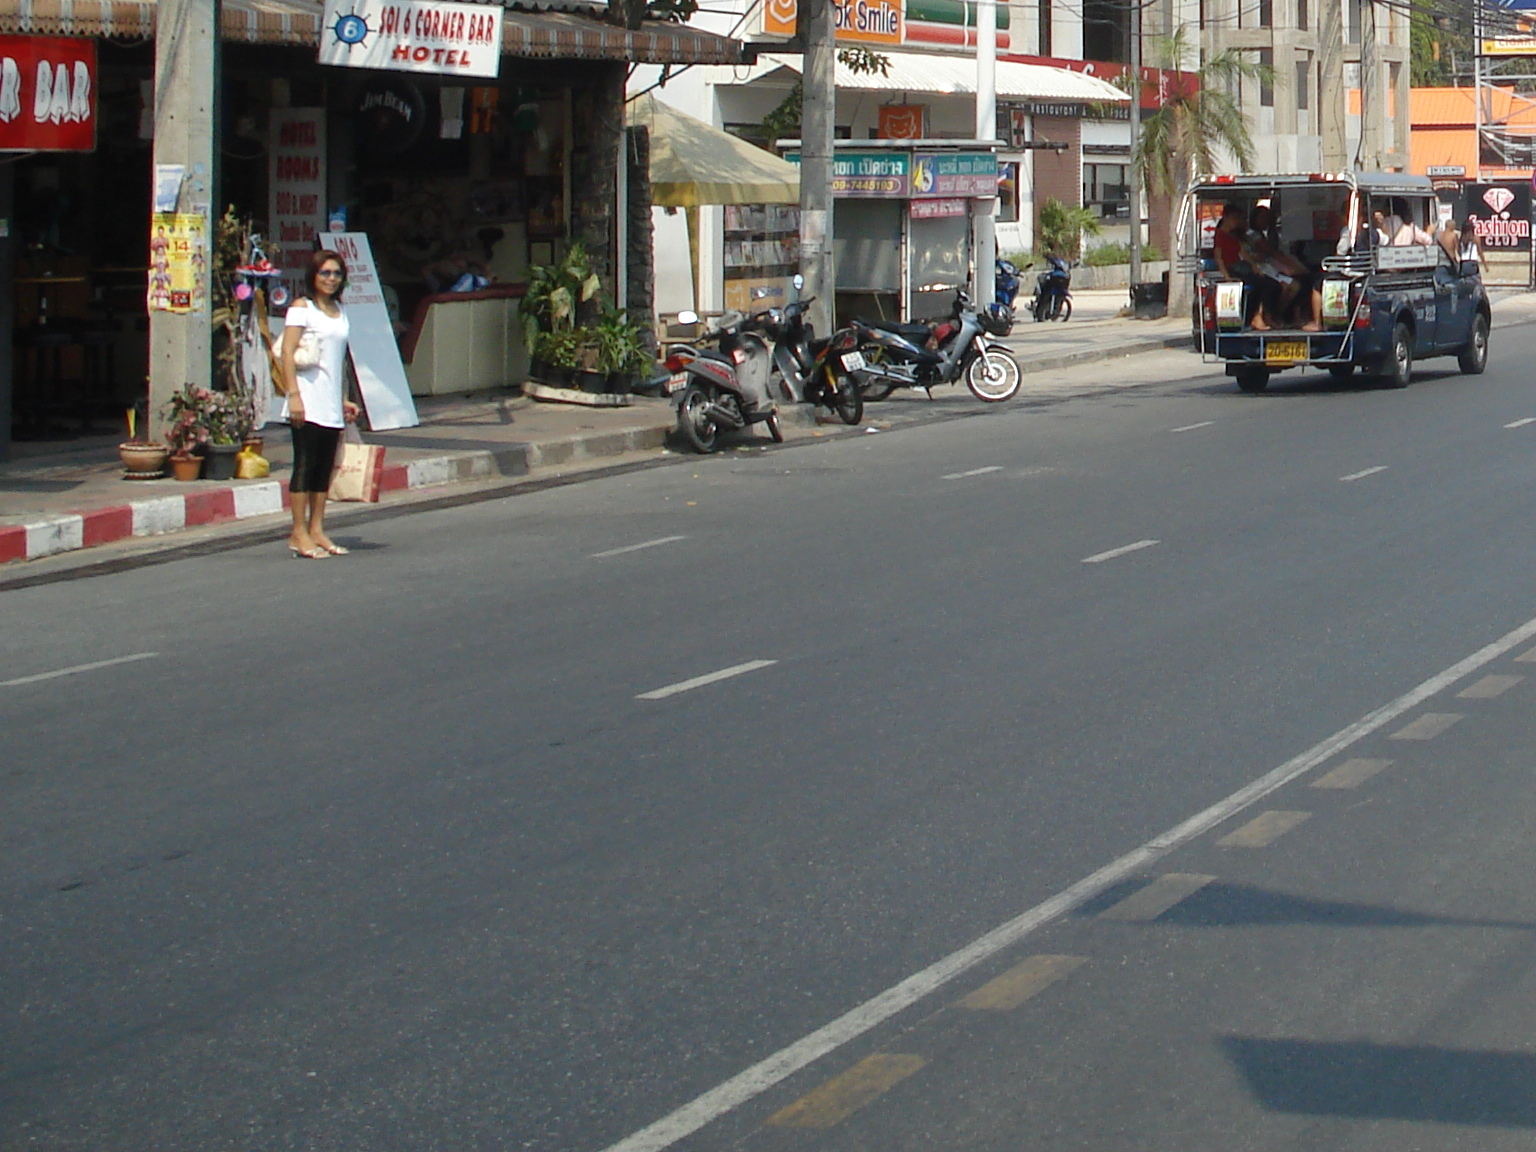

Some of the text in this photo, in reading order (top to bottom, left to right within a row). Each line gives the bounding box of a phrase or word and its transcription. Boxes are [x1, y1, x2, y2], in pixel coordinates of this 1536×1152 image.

[343, 19, 358, 39] 6
[379, 5, 495, 44] SOI 6 CORNER BAR
[855, 0, 898, 34] Smile
[392, 43, 472, 68] HOTEL
[34, 59, 91, 126] BAR
[276, 155, 319, 181] ROOMS
[1468, 211, 1530, 237] fashion
[1485, 235, 1519, 247] CLUB
